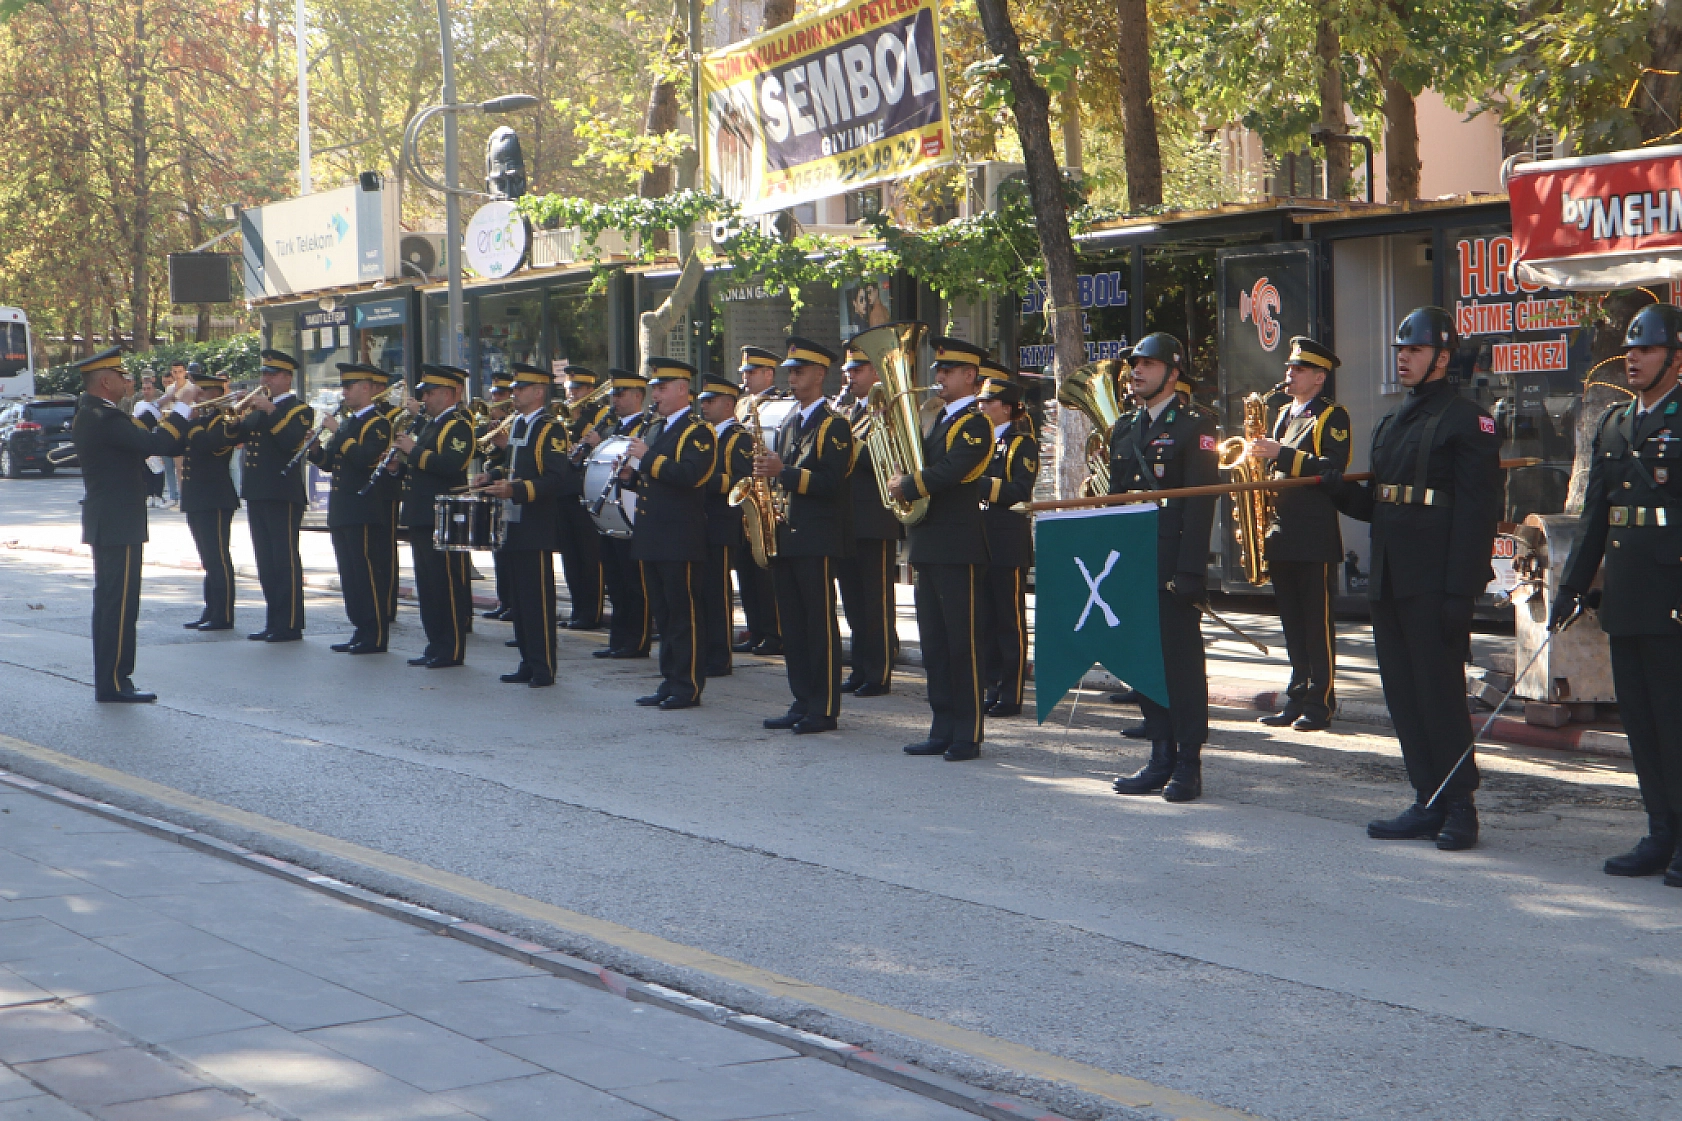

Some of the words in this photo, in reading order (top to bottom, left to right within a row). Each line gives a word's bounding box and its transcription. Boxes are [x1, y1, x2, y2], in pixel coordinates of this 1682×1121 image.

[745, 23, 823, 72] OKULLARIN
[761, 22, 936, 143] SEMBOL
[276, 239, 295, 257] Türk
[296, 232, 334, 253] Telekom
[1456, 299, 1513, 339] İŞİTME
[1492, 333, 1568, 374] MERKEZİ
